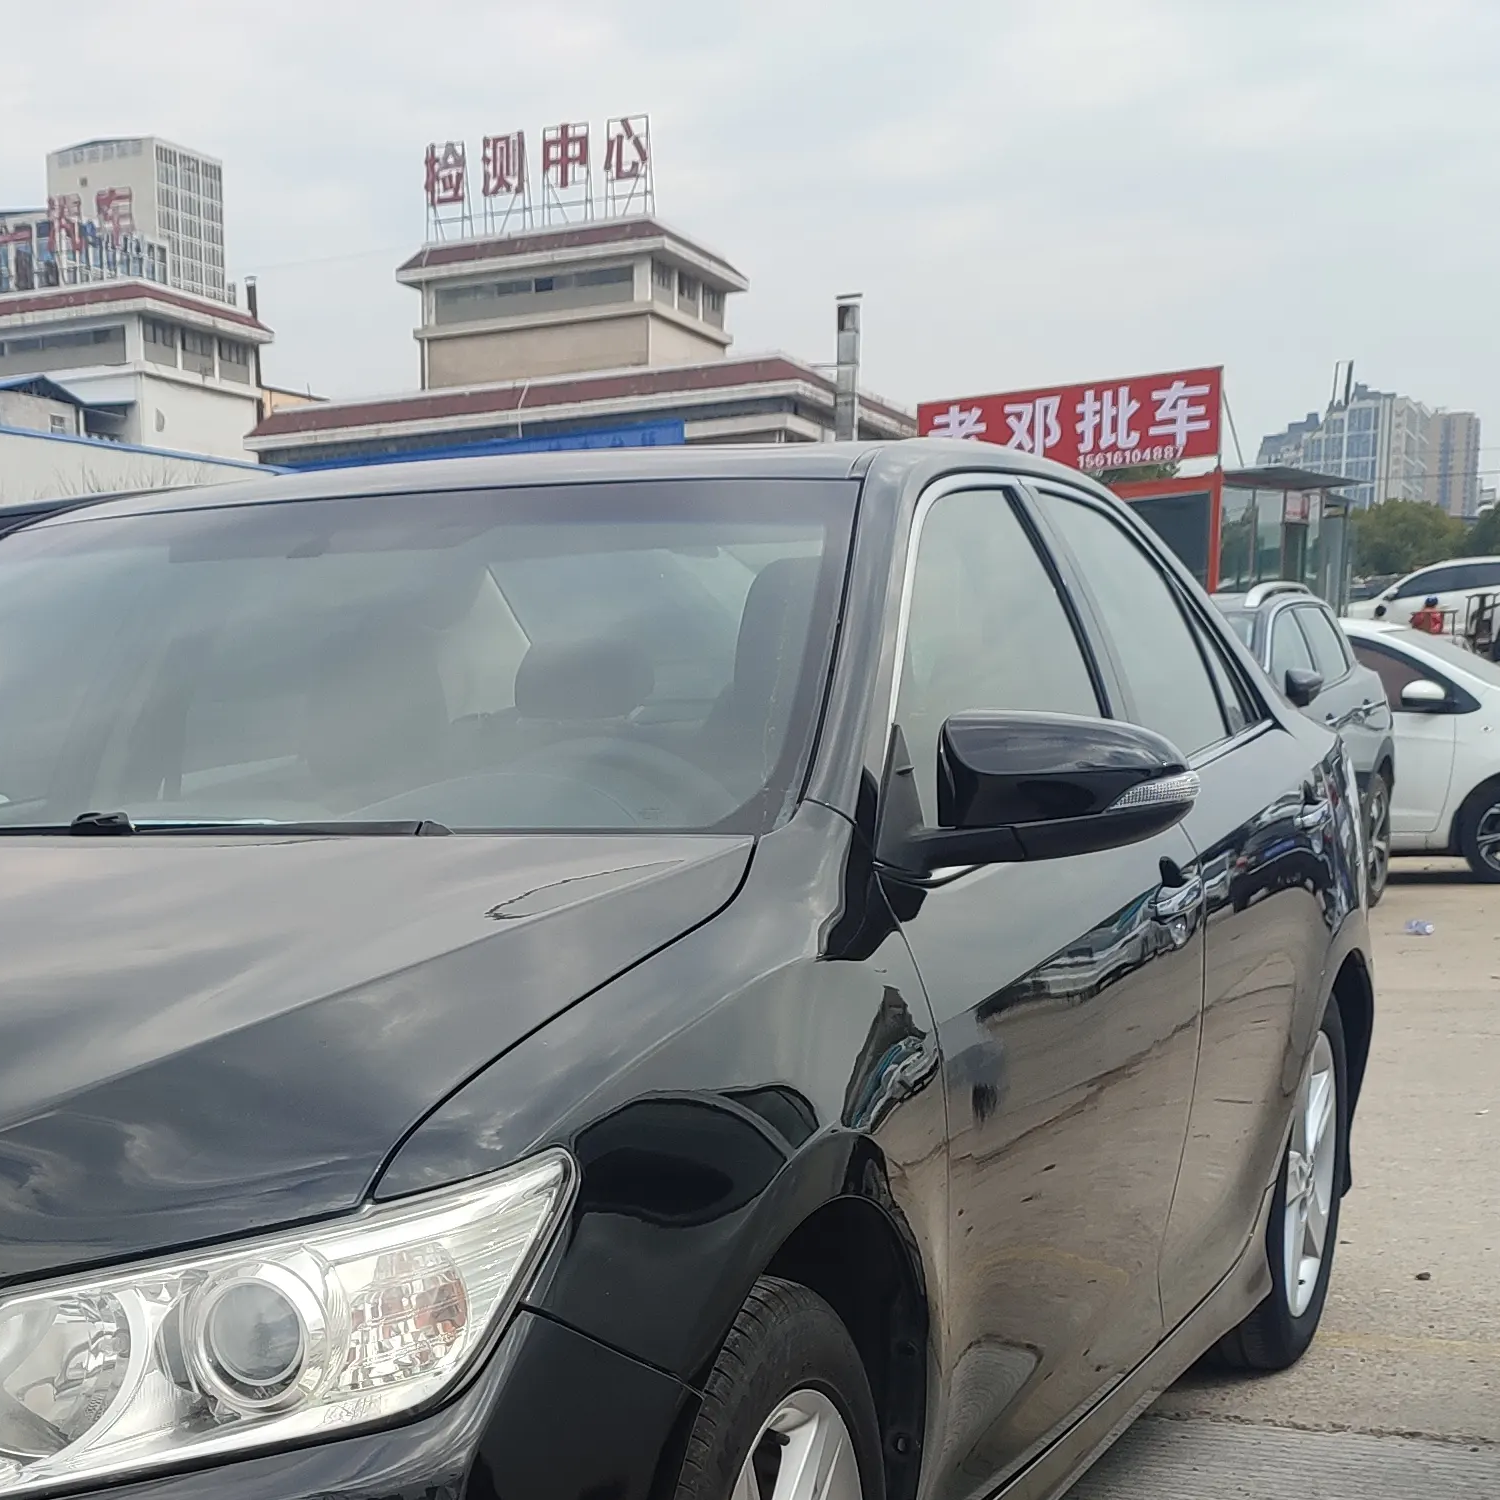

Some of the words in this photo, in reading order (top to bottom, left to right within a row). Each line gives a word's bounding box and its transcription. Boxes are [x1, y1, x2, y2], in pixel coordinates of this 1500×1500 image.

[424, 117, 648, 205] 检测中心
[927, 380, 1211, 457] 老邓批车
